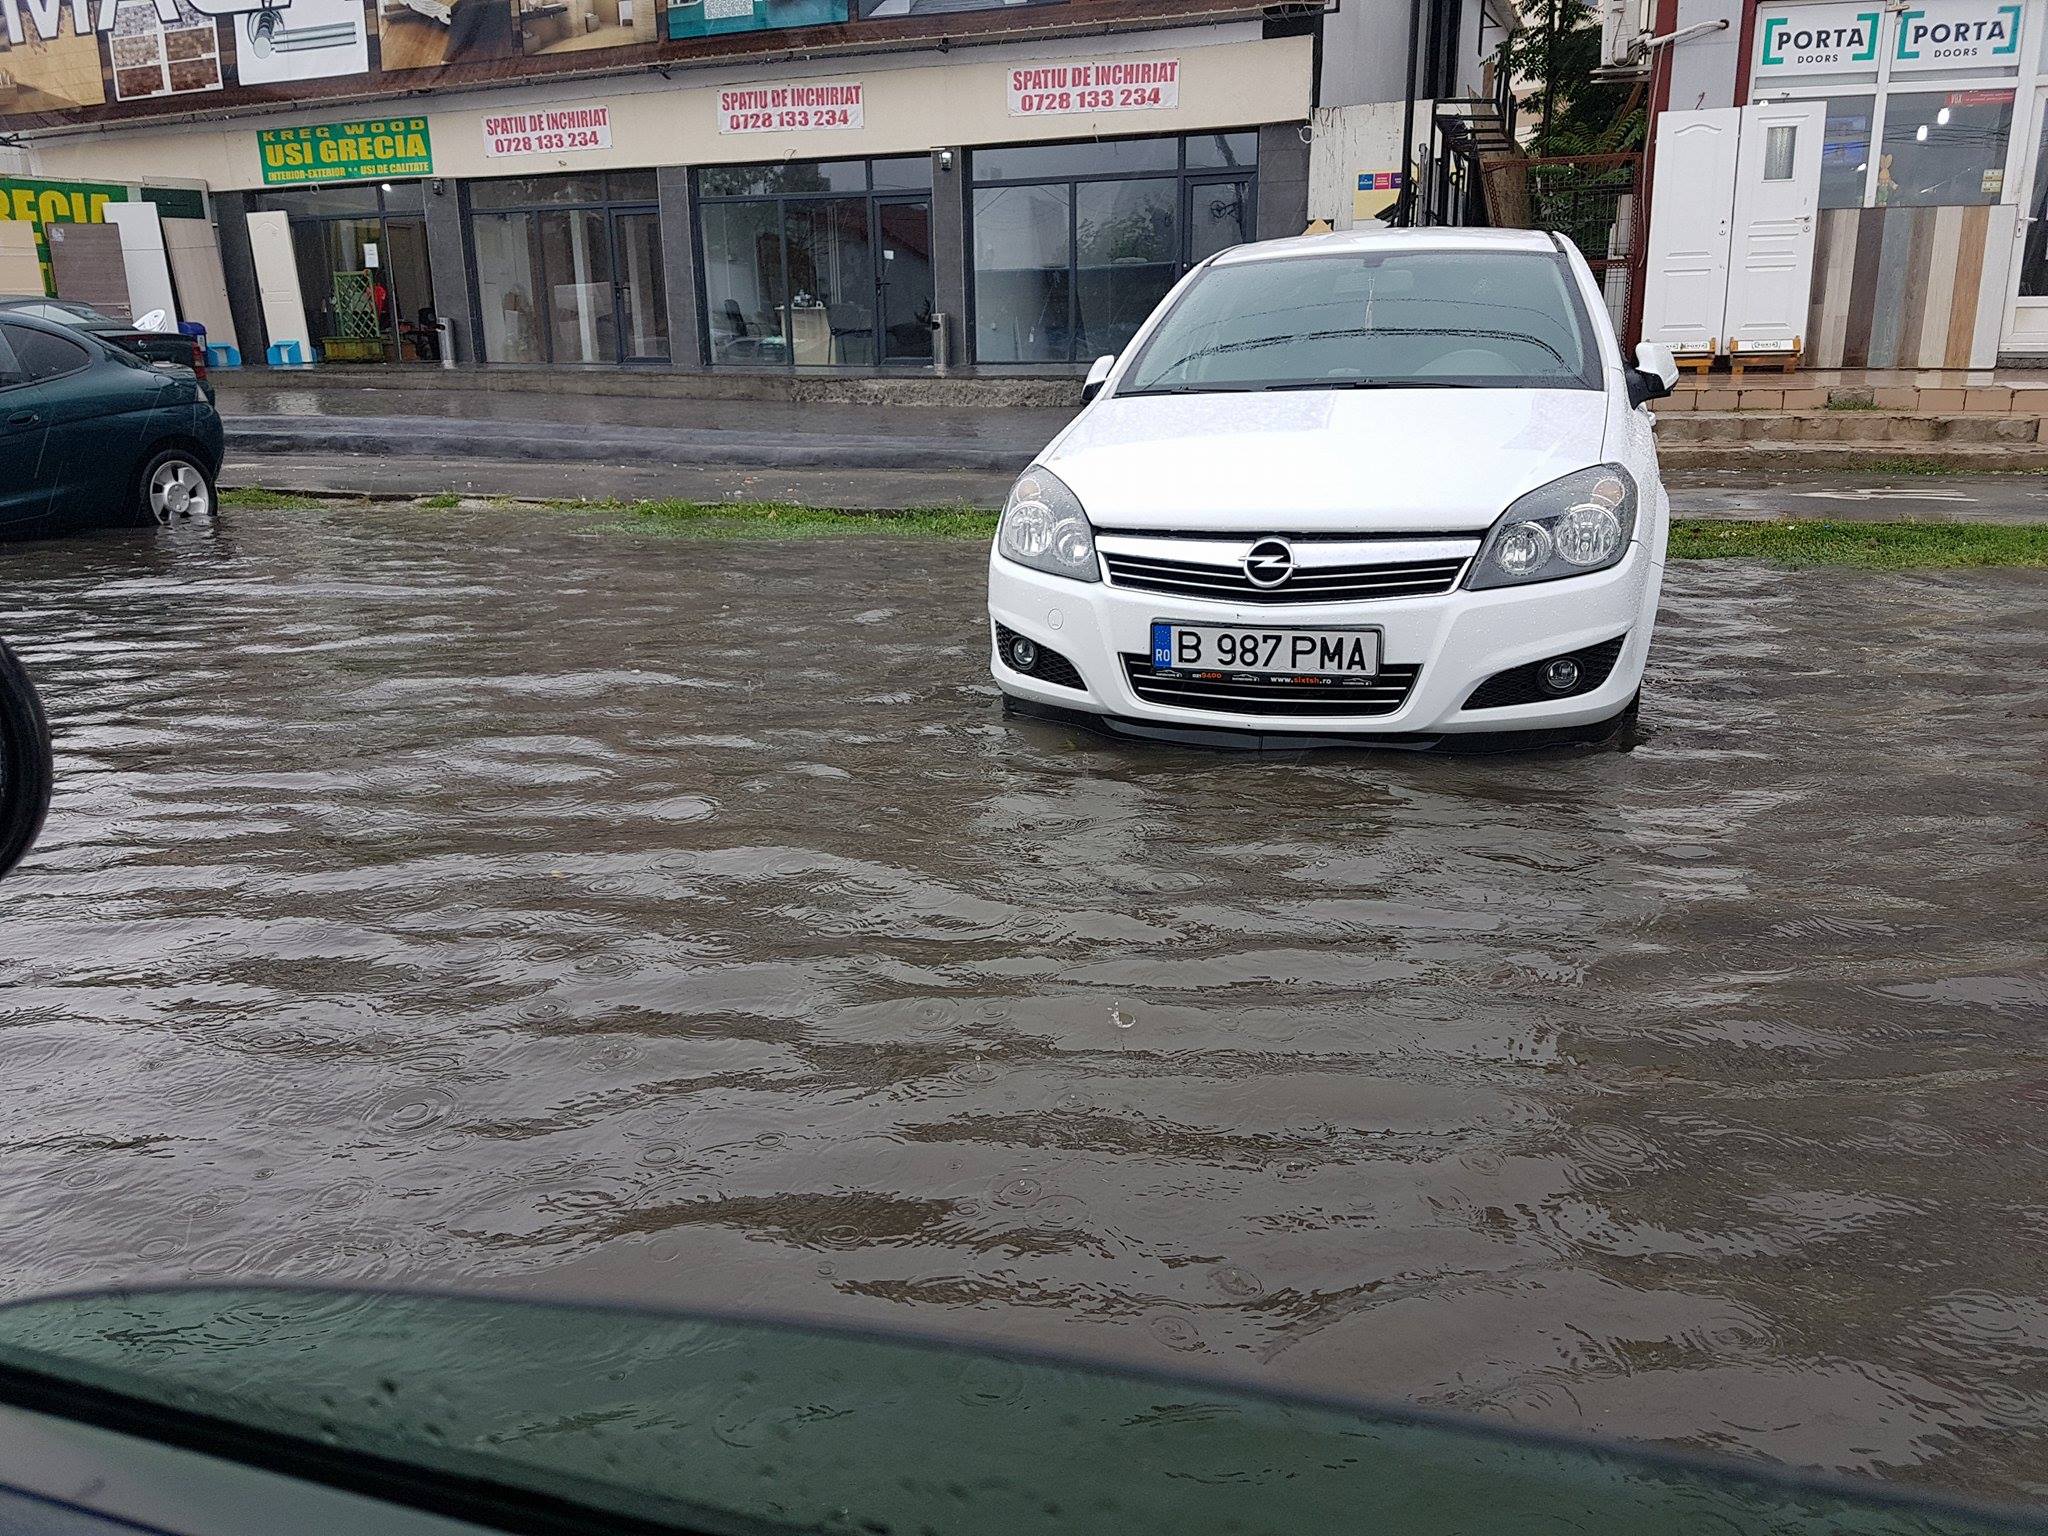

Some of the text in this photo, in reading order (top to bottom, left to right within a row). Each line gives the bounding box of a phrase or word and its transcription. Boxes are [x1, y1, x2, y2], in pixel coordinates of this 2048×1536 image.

[1777, 28, 1864, 50] PORTA
[1913, 20, 2006, 44] PORTA
[1797, 54, 1839, 64] DOORS
[1934, 47, 1978, 58] DOORS
[1013, 62, 1178, 91] SPATIU DE INCHIRIAT
[722, 85, 861, 111] SPATIU DE INCHIRIAT
[1021, 87, 1161, 111] 0728 133 234
[262, 119, 425, 142] KREG WOOD
[486, 108, 607, 136] SPATIU DE INCHIRIAT
[730, 109, 849, 130] 0728 133 234
[265, 133, 428, 167] USI GRECIA
[495, 130, 599, 153] 0728 133 234
[268, 161, 429, 182] INTERIOR-EXTERIOR USI DE CALITATE
[1155, 648, 1170, 662] RO
[1178, 630, 1366, 670] B 987 PMA
